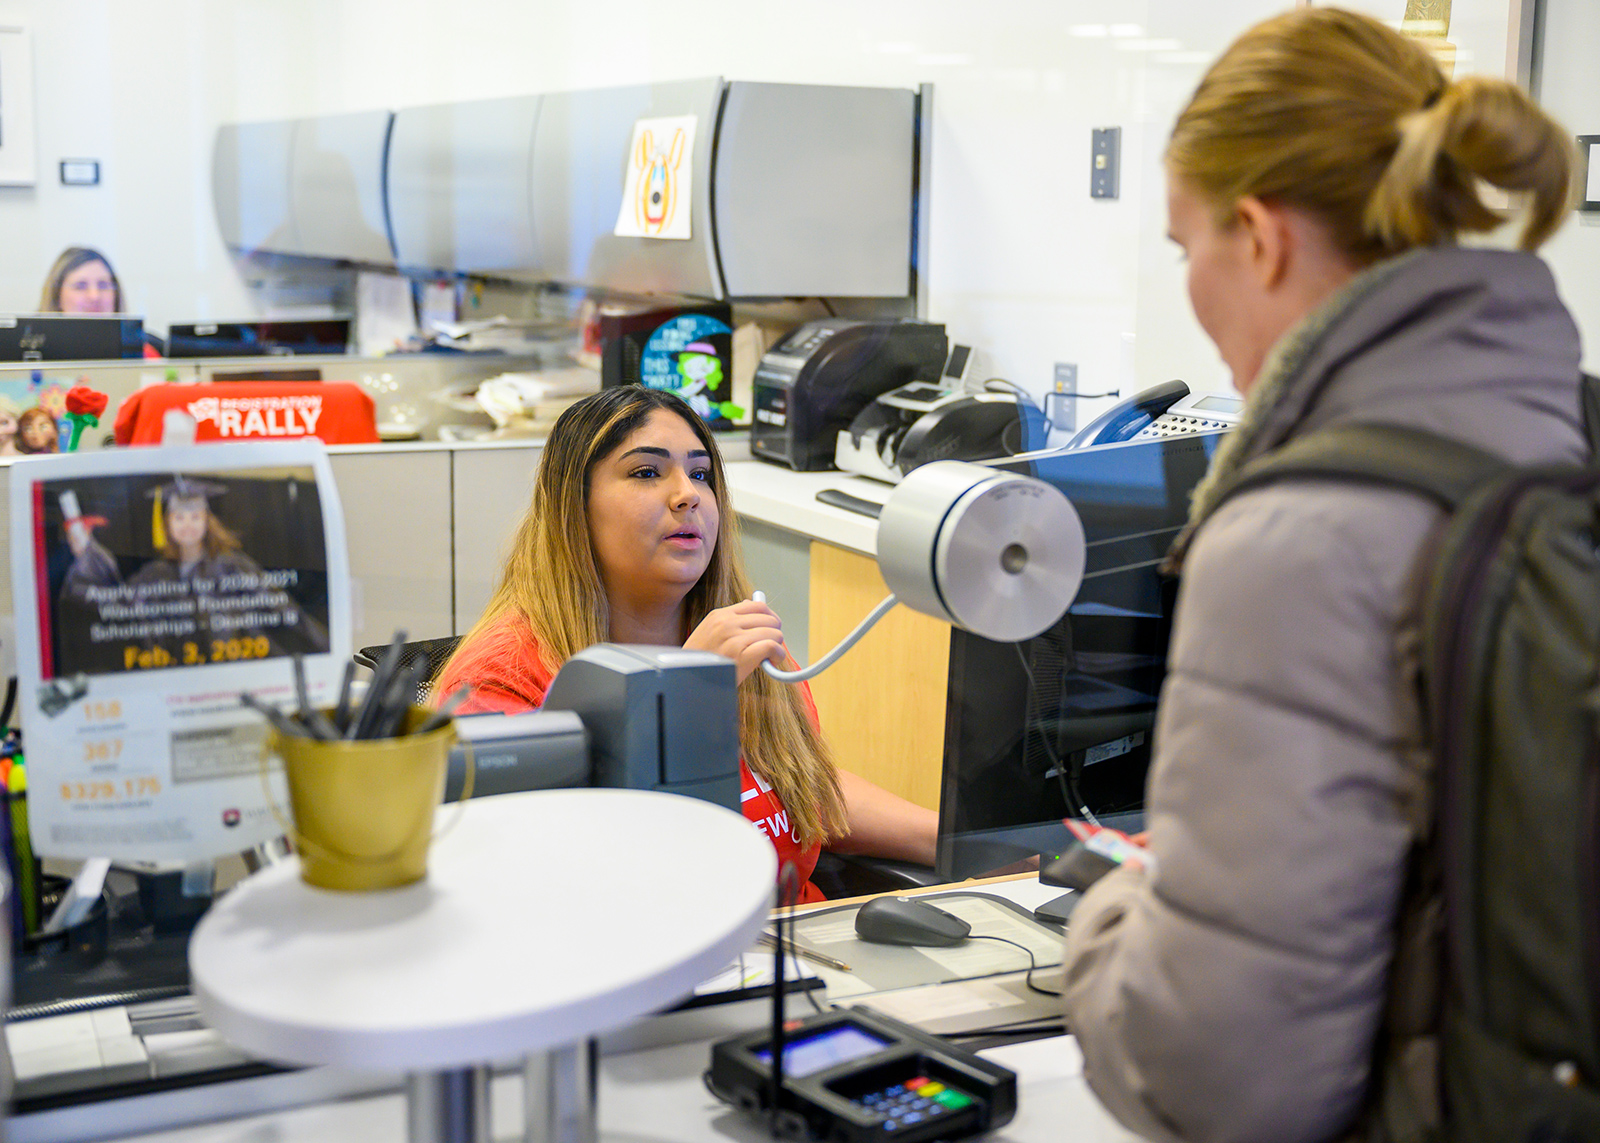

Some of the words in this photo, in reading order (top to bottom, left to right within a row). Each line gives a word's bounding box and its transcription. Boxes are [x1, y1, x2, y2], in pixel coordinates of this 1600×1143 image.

[221, 395, 322, 411] REGISTRATION
[220, 407, 322, 437] RALLY
[86, 584, 135, 604] Apply
[138, 580, 189, 596] online
[193, 578, 214, 592] for
[199, 592, 287, 614] Foundation
[91, 619, 195, 641] Scholarships
[211, 611, 280, 631] Deadline
[124, 646, 177, 669] Feb.
[183, 642, 206, 665] 3,
[211, 636, 270, 661] 2020
